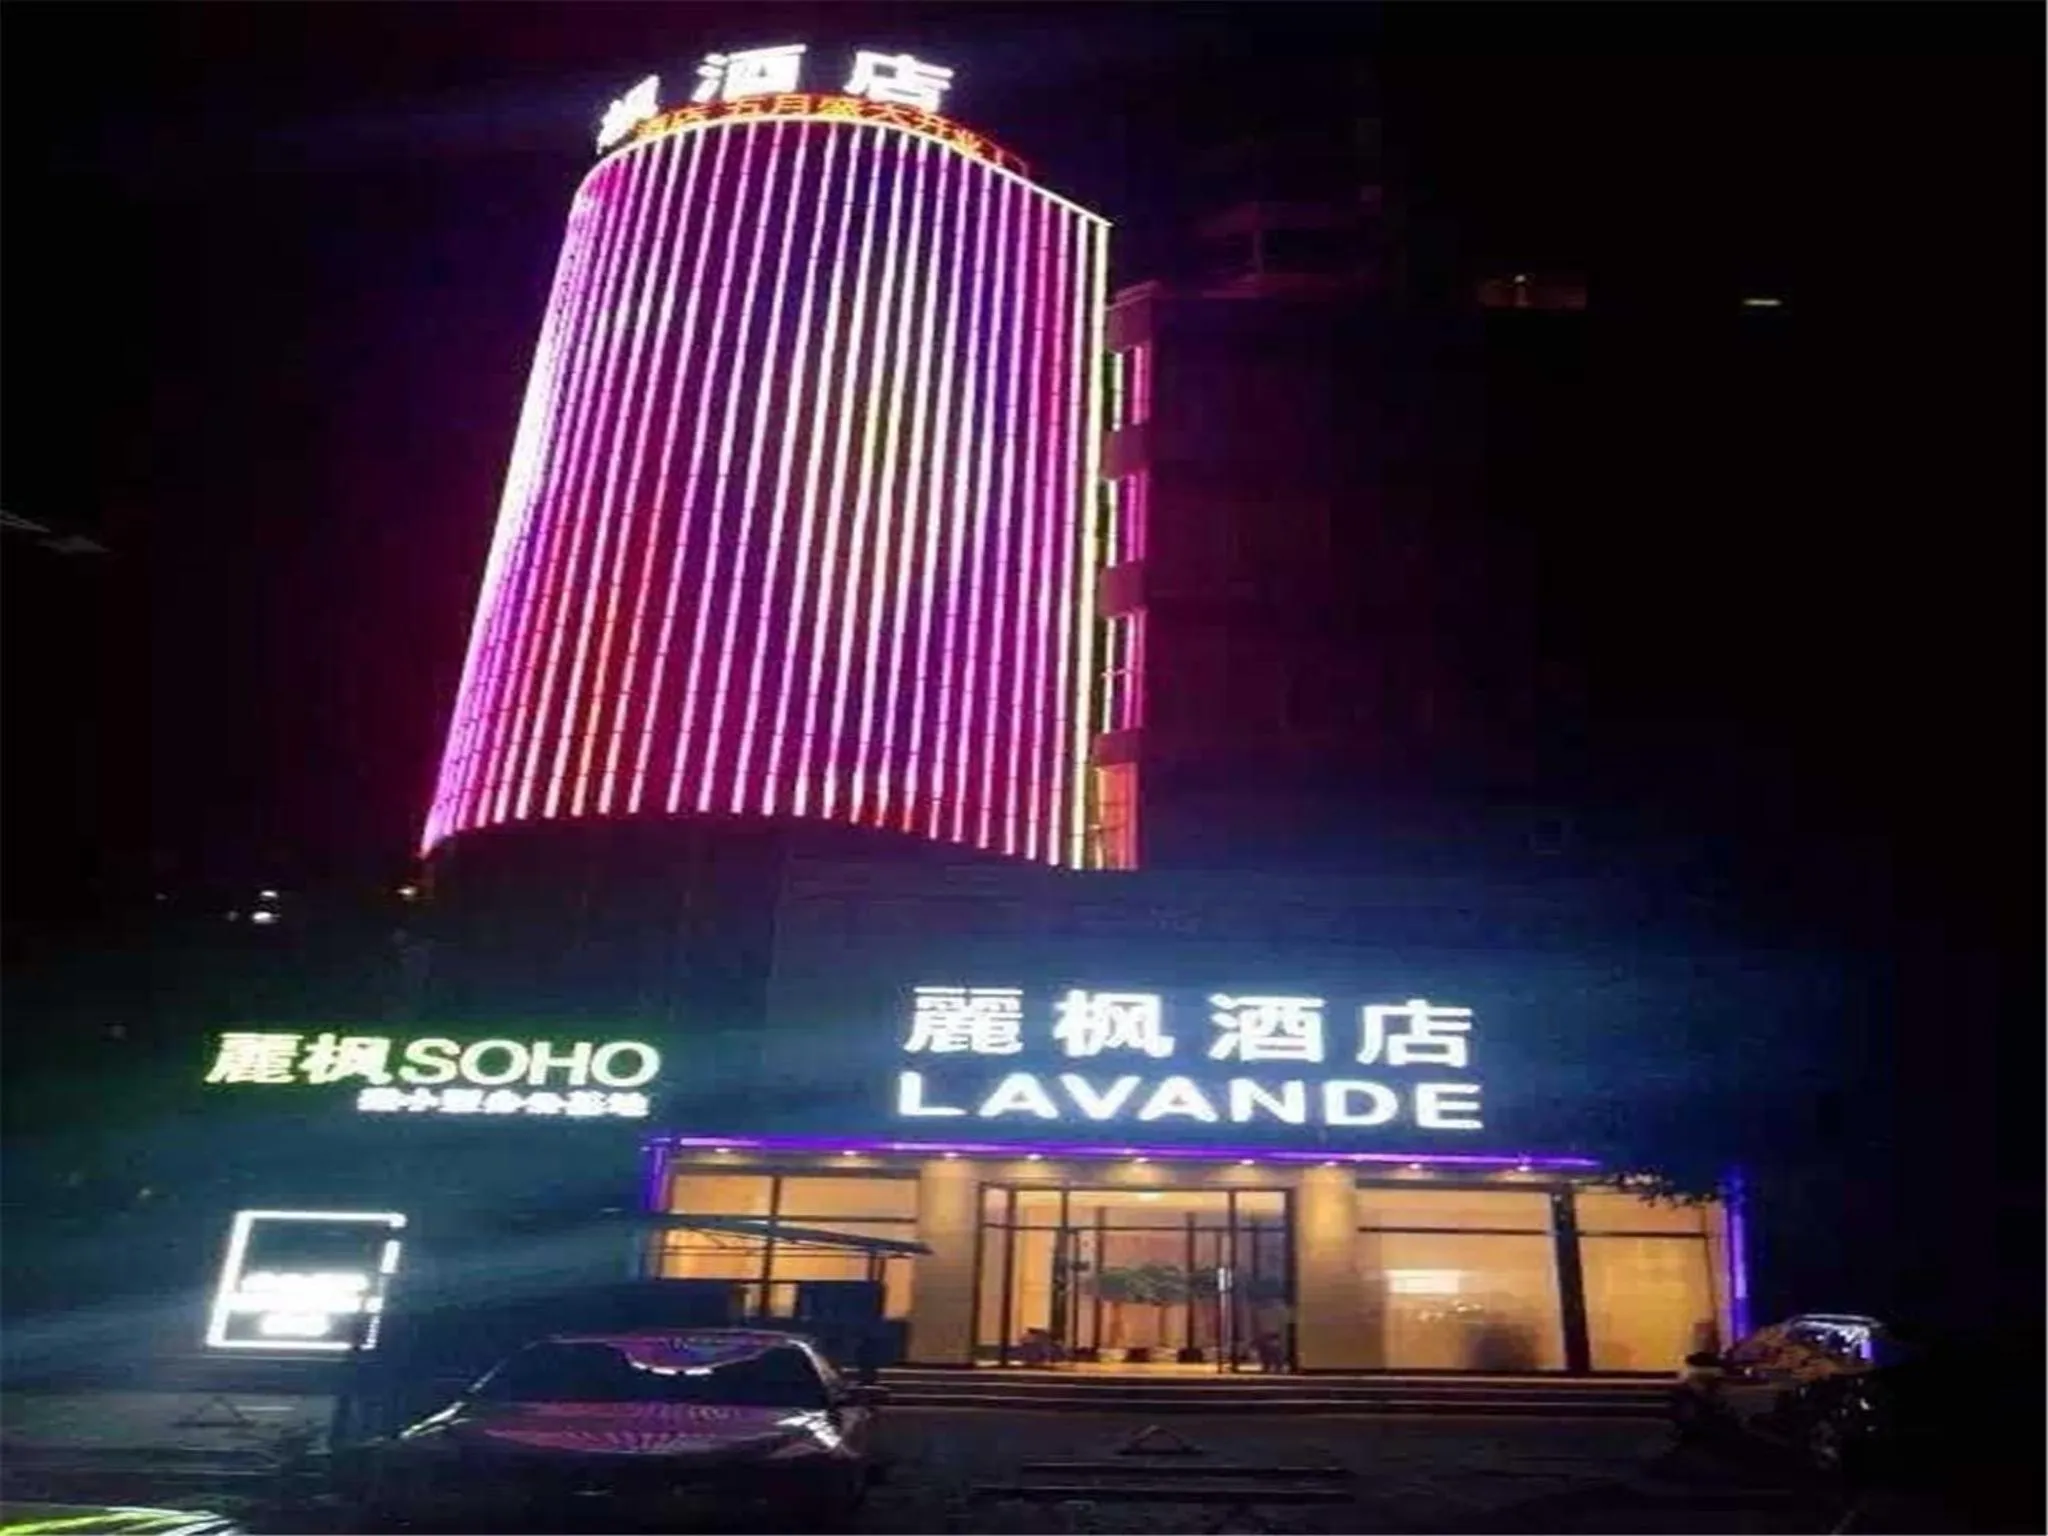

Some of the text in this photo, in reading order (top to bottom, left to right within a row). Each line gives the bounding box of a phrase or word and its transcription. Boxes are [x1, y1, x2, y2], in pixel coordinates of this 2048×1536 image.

[904, 985, 1474, 1068] 麗枫酒店
[899, 1072, 1484, 1129] LAVANDE
